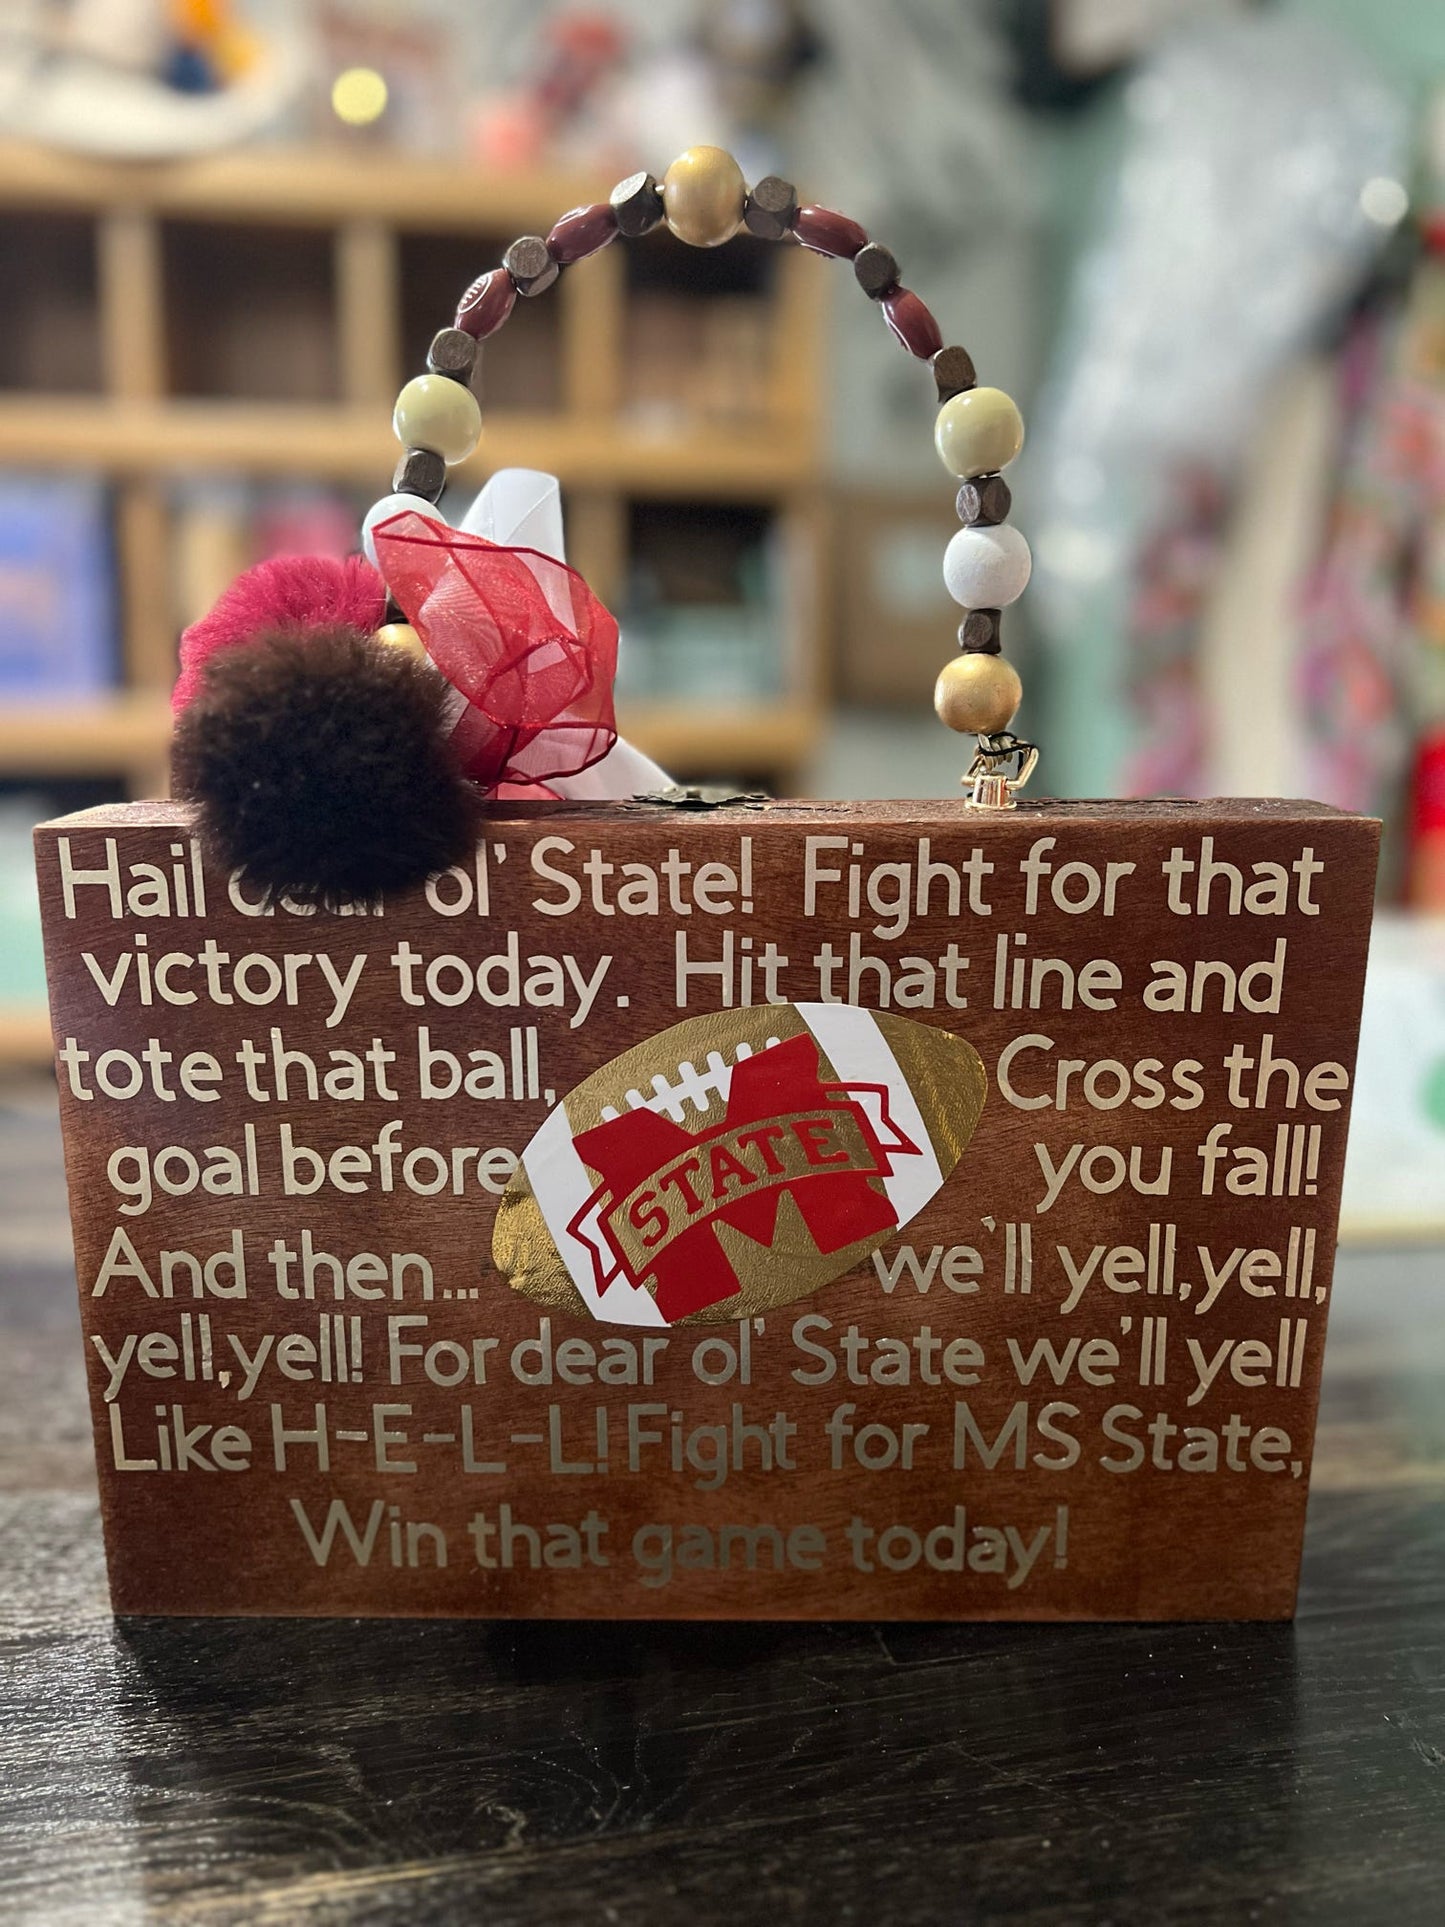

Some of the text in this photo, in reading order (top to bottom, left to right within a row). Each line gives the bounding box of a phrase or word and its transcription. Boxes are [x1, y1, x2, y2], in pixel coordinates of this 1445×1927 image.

[61, 837, 206, 919] Hail
[425, 839, 507, 917] ol'
[532, 836, 753, 917] State!
[803, 836, 994, 940] Fight
[1020, 837, 1136, 916] for
[1162, 837, 1325, 916] that
[82, 931, 1287, 1028] victory today. Hit that line and
[60, 1027, 1349, 1111] tote that ball, Cross the
[108, 1120, 1321, 1216] goal before you fall!
[628, 1119, 852, 1249] STATE
[92, 1227, 247, 1299] And
[268, 1229, 479, 1300] then...
[388, 1315, 499, 1386] For
[510, 1317, 669, 1386] dear
[692, 1318, 766, 1386] ol'
[791, 1314, 985, 1387] State
[1006, 1316, 1167, 1387] we'll
[1186, 1318, 1307, 1407] yell
[108, 1403, 252, 1472] Like
[628, 1402, 797, 1491] Fight
[825, 1402, 930, 1471] for
[953, 1401, 1082, 1470] MS
[1099, 1404, 1304, 1478] State,
[290, 1499, 1070, 1590] Win that game today!
